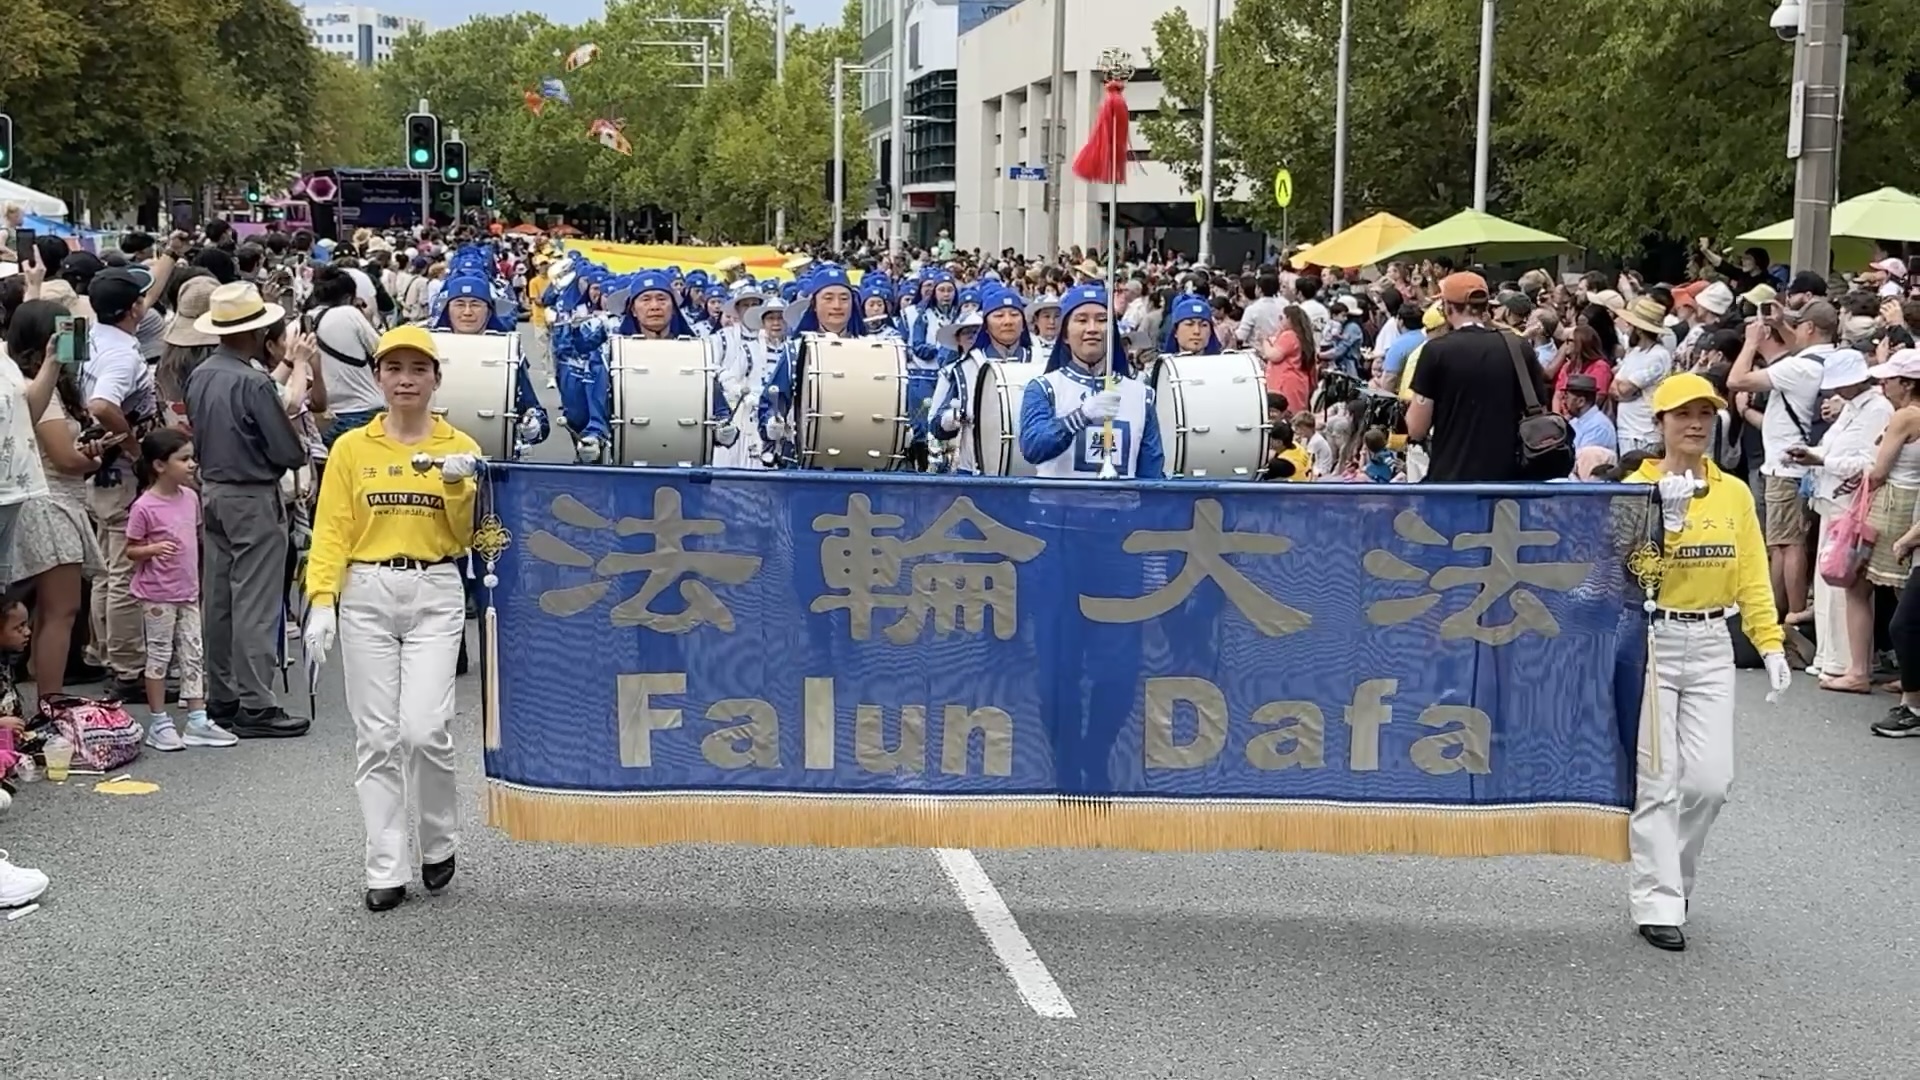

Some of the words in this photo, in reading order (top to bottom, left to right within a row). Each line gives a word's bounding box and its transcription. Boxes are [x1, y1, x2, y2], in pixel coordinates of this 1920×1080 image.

[368, 494, 408, 504] FALUN
[412, 494, 443, 508] DAFA
[527, 486, 1594, 646] 法輪大法
[1675, 547, 1700, 557] LUN
[1705, 546, 1735, 556] DAFA
[616, 672, 1014, 778] Falun
[1144, 677, 1493, 776] Dafa
